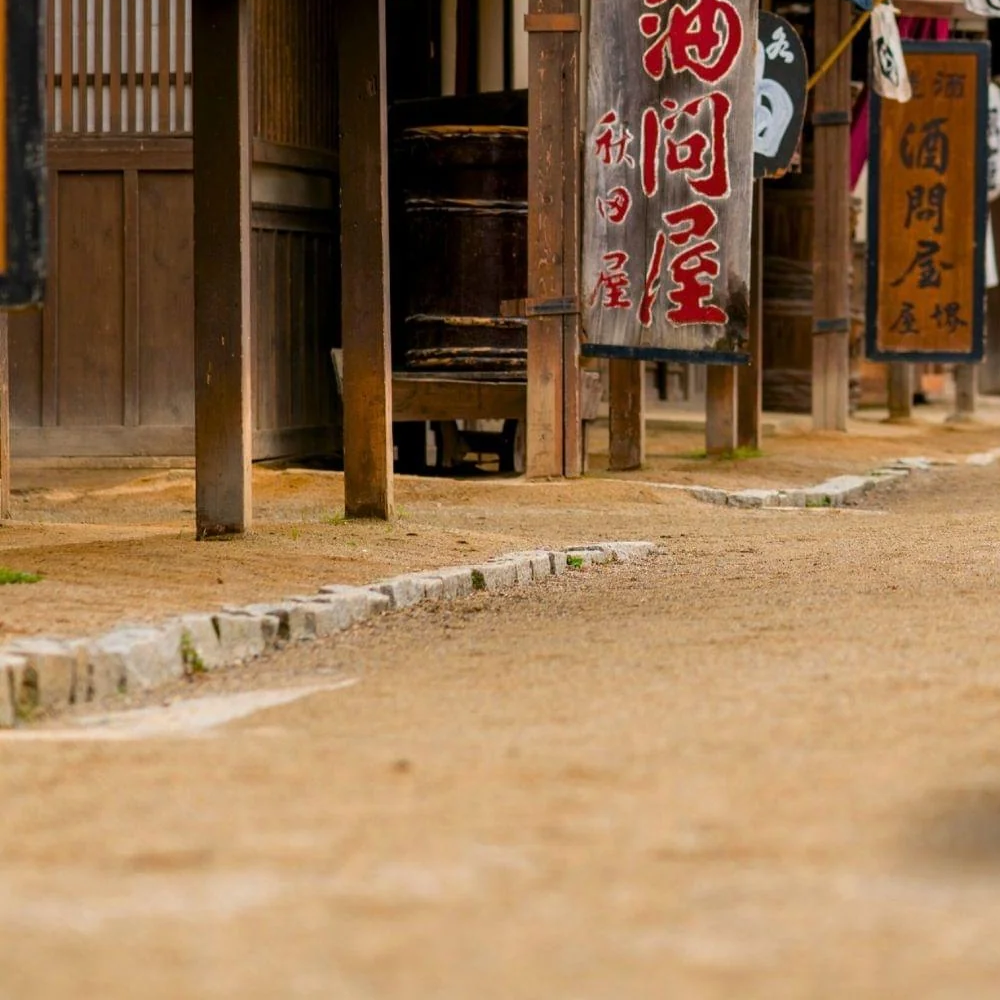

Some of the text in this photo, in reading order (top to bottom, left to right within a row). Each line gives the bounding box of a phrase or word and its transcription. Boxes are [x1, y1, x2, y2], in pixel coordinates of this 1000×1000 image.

[590, 108, 635, 310] 秋田屋
[891, 116, 956, 290] 酒問屋
